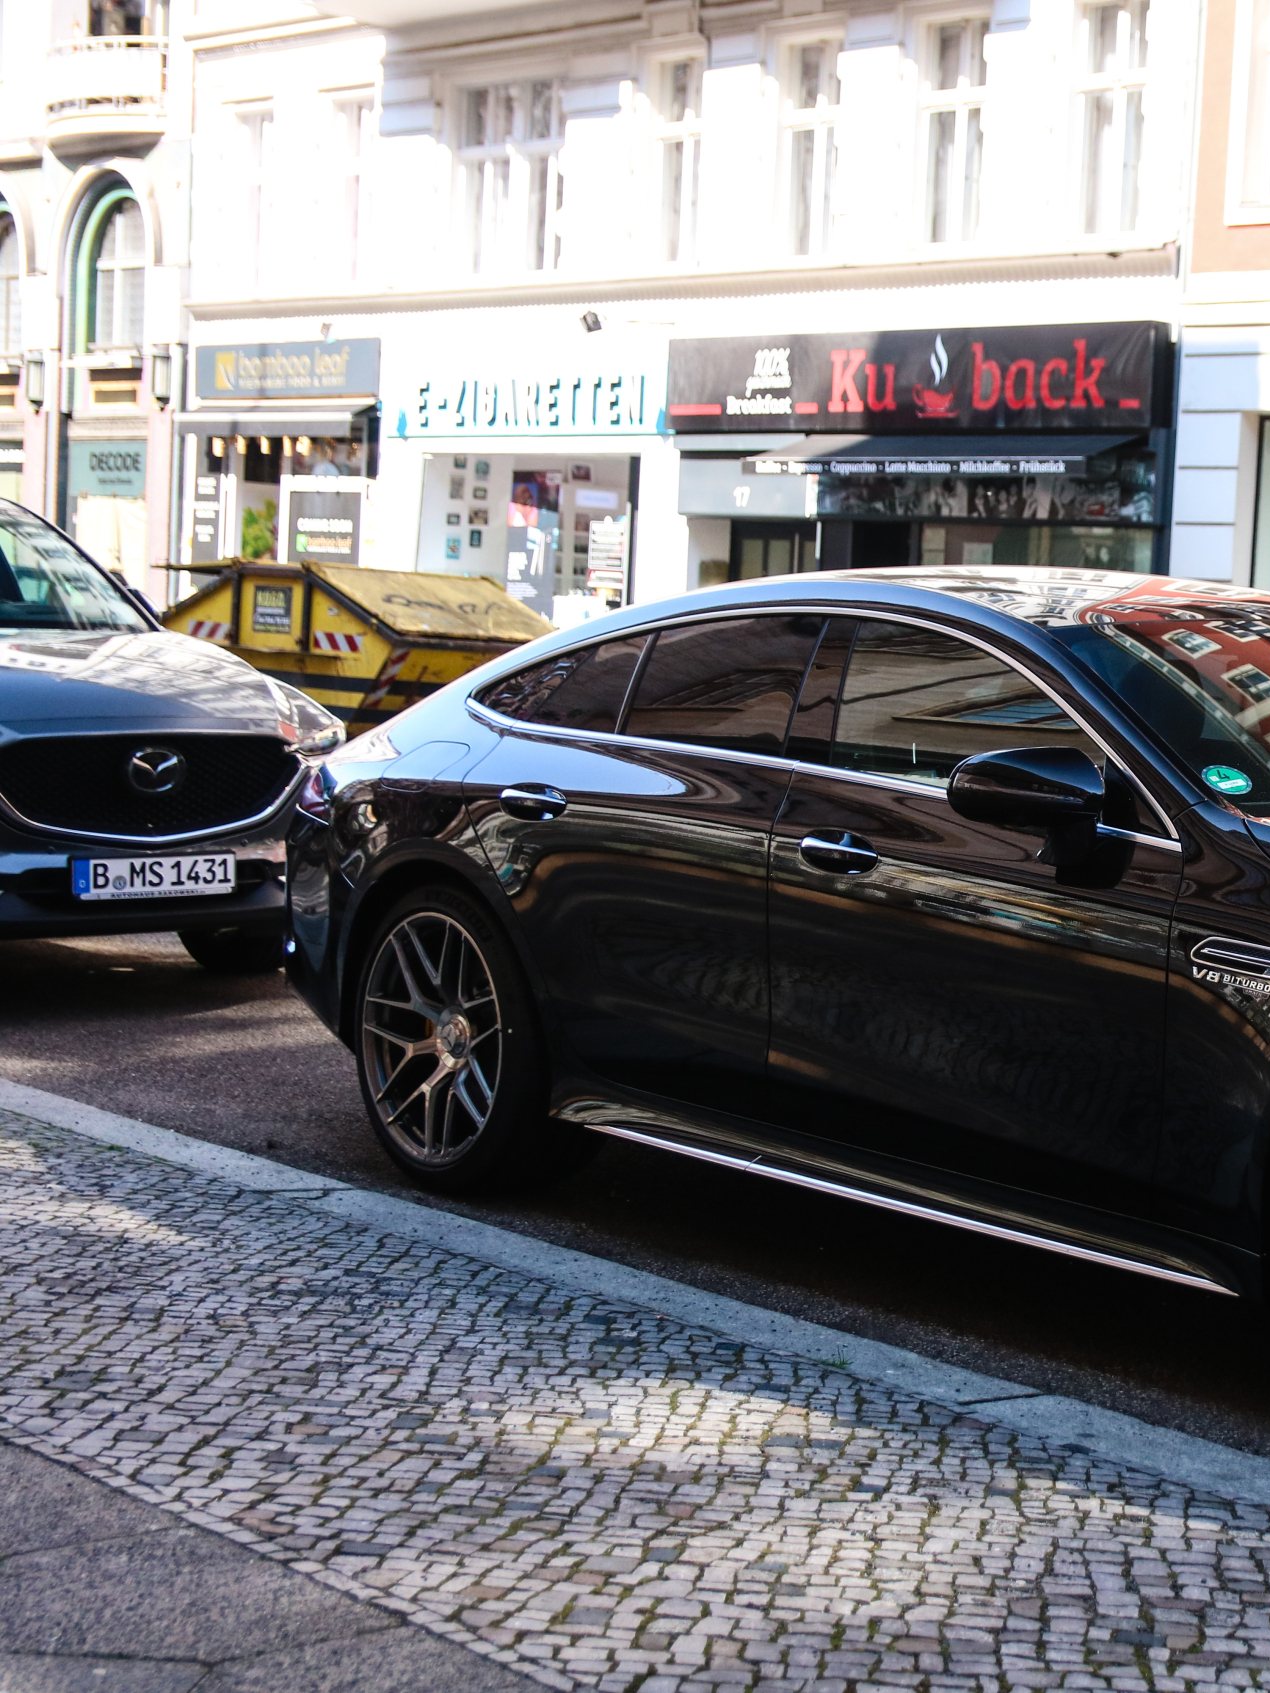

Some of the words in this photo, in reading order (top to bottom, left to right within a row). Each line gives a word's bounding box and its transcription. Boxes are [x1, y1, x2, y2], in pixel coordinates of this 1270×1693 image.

[828, 349, 898, 413] Ku
[971, 338, 1106, 410] back
[726, 394, 792, 415] Breakfast
[89, 451, 141, 471] DECODE
[830, 461, 877, 475] Cappuccino
[884, 461, 906, 473] Latte
[907, 461, 951, 473] Macchiato
[959, 461, 1010, 473] Milchkaffee
[1019, 460, 1066, 473] Frühstück
[733, 486, 750, 507] 17
[93, 863, 110, 889] B
[130, 861, 164, 888] MS
[171, 858, 232, 886] 1431
[1192, 965, 1221, 983] V8
